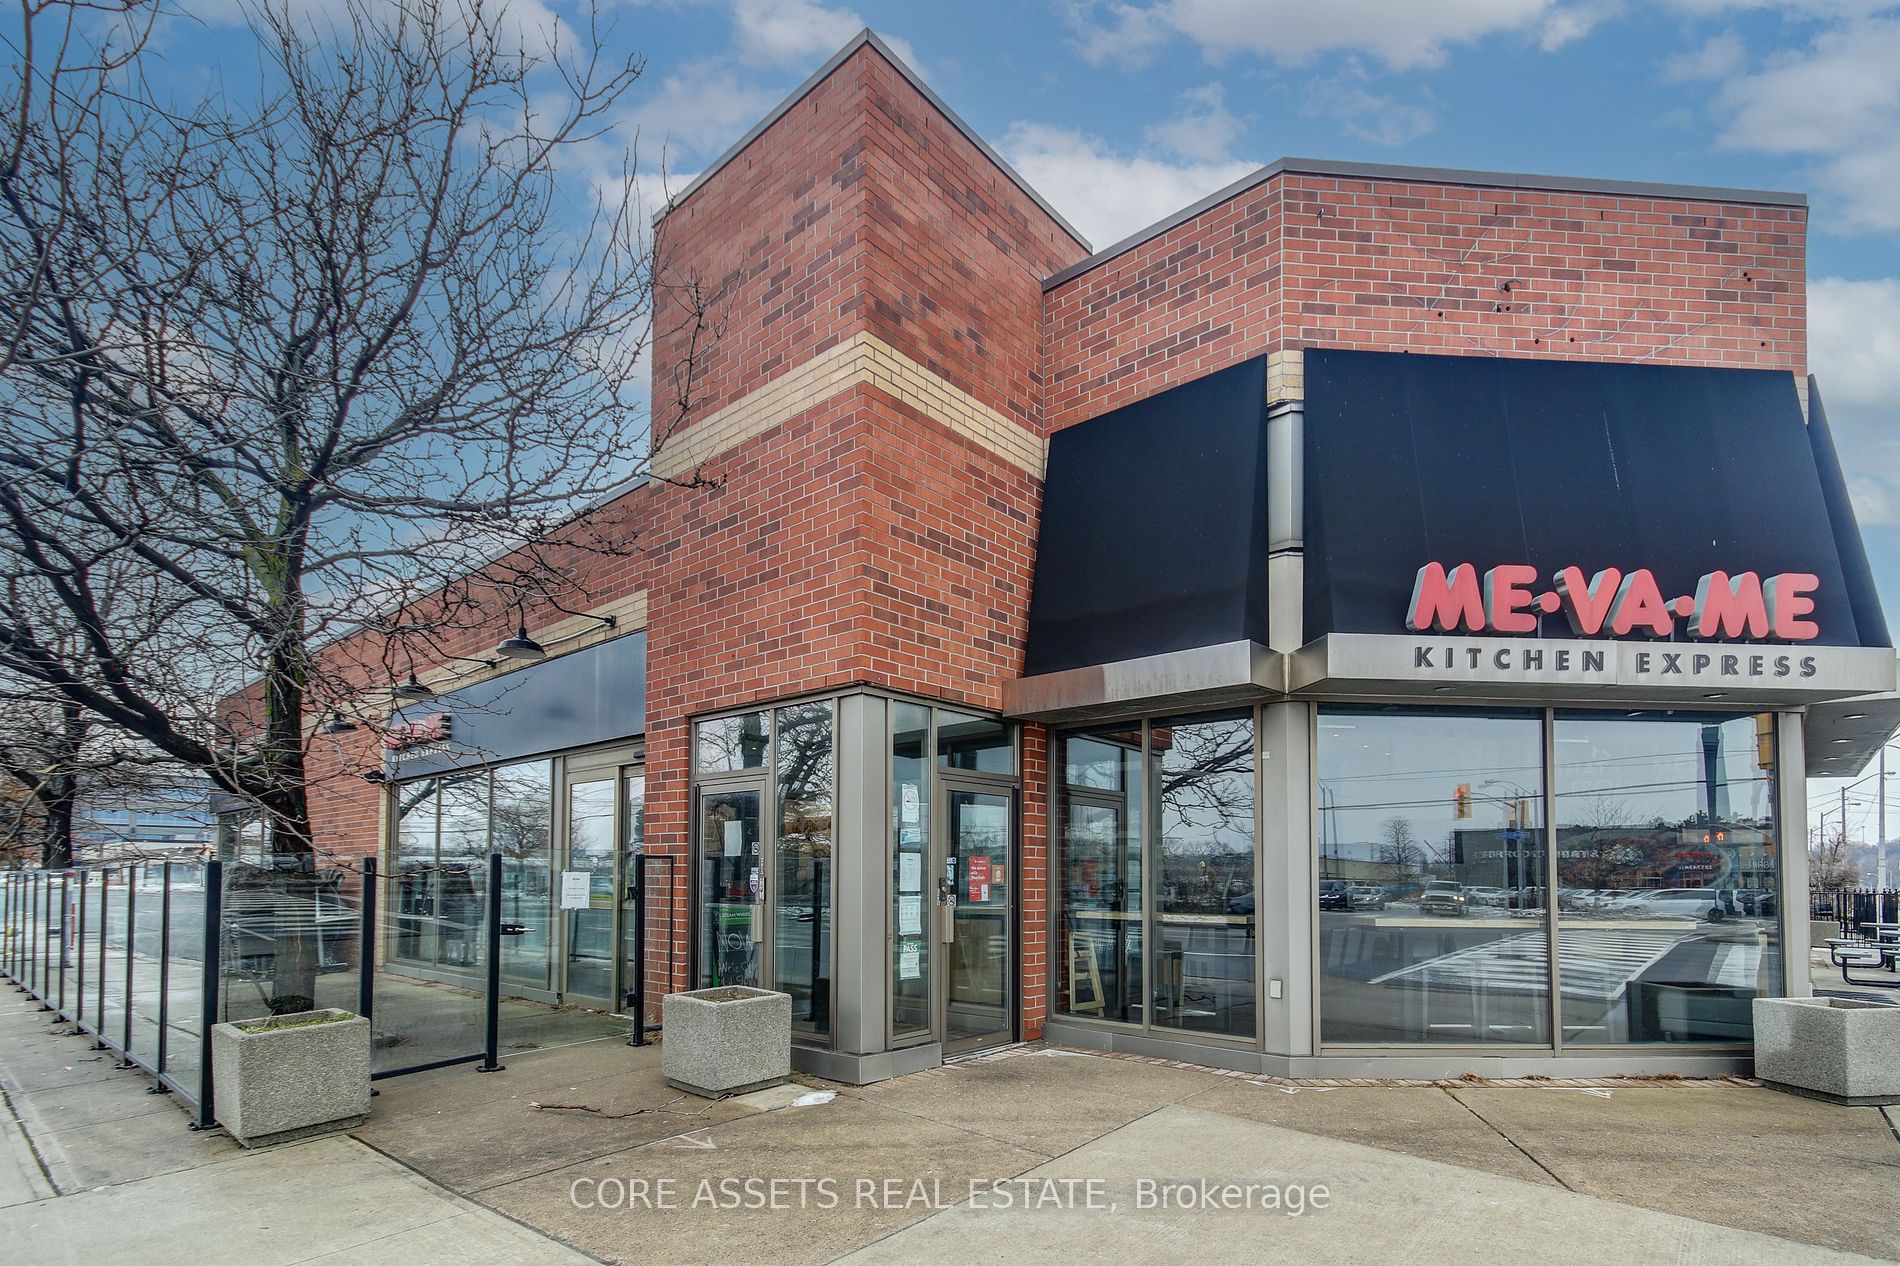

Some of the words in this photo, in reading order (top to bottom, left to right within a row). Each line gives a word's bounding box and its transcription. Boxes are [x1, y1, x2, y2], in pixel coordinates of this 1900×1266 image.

[1414, 646, 1604, 672] KITCHEN
[1636, 652, 1817, 678] EXPRESS
[903, 944, 918, 953] PASS
